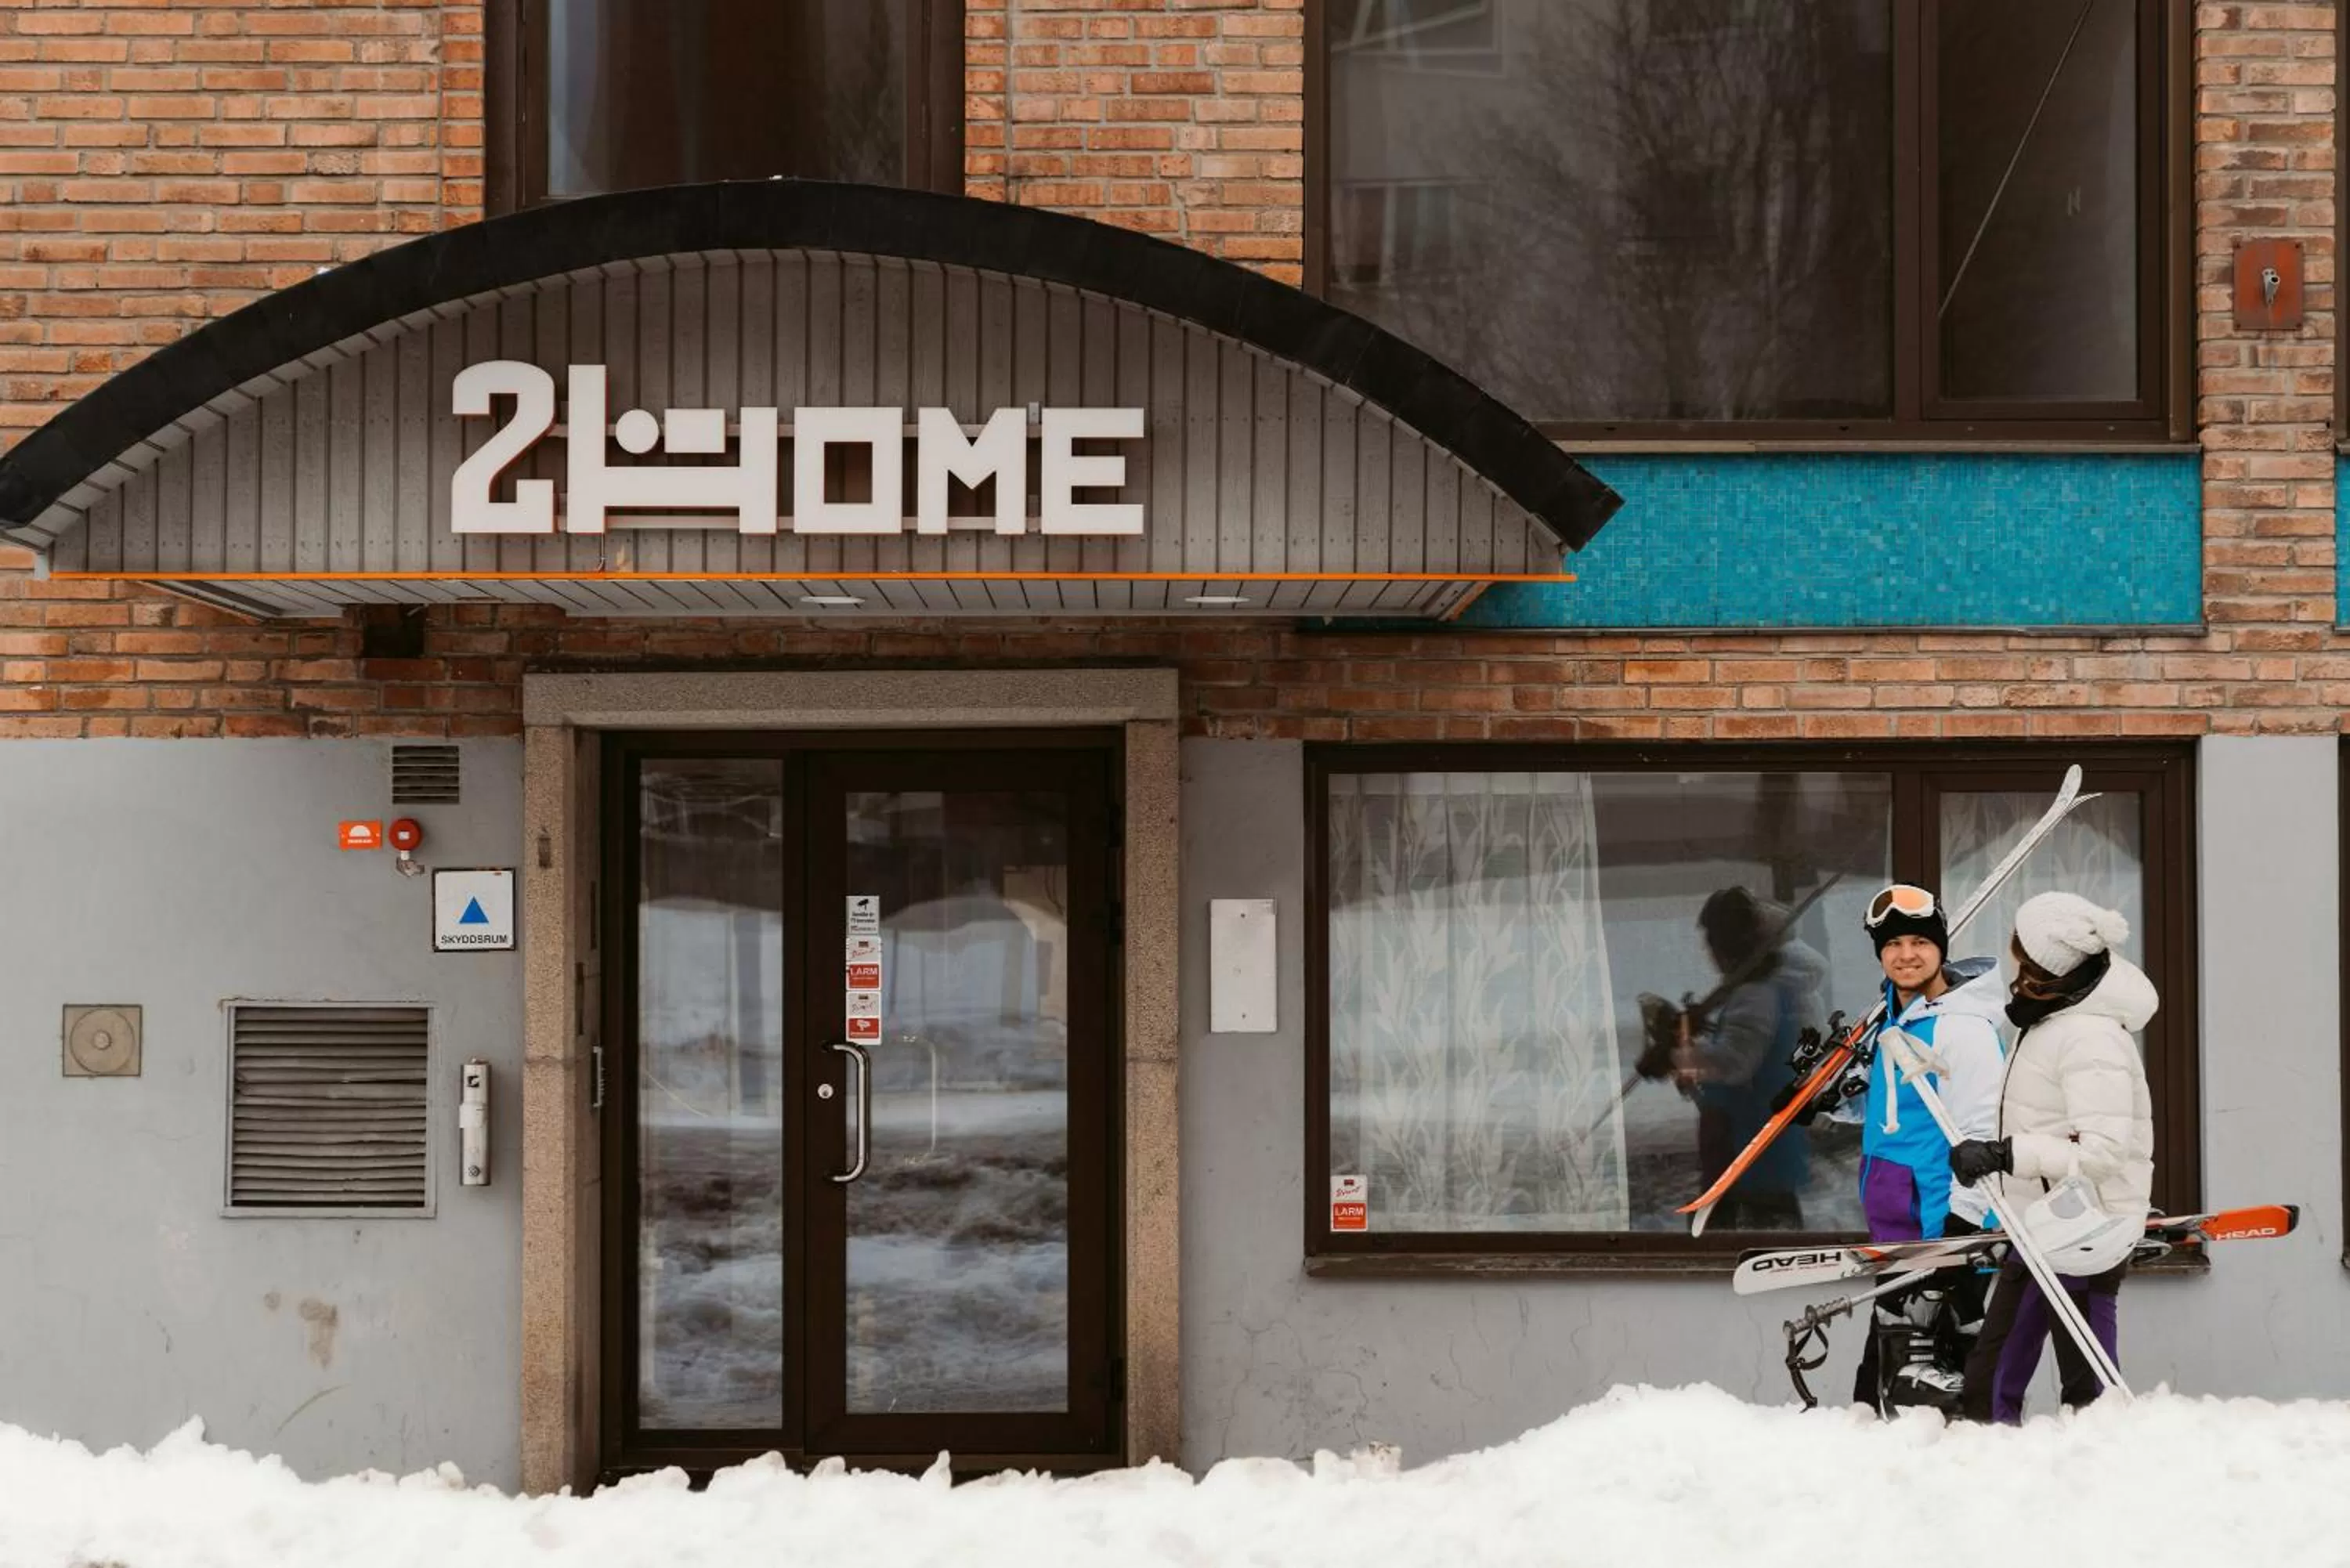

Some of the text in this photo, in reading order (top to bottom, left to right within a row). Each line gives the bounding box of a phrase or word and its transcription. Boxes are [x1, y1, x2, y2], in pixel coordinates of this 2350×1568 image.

[440, 934, 508, 944] SKYDDSRUM
[1334, 1206, 1364, 1216] LARM
[2216, 1227, 2277, 1241] HEAD
[1752, 1252, 1842, 1272] HEAD
